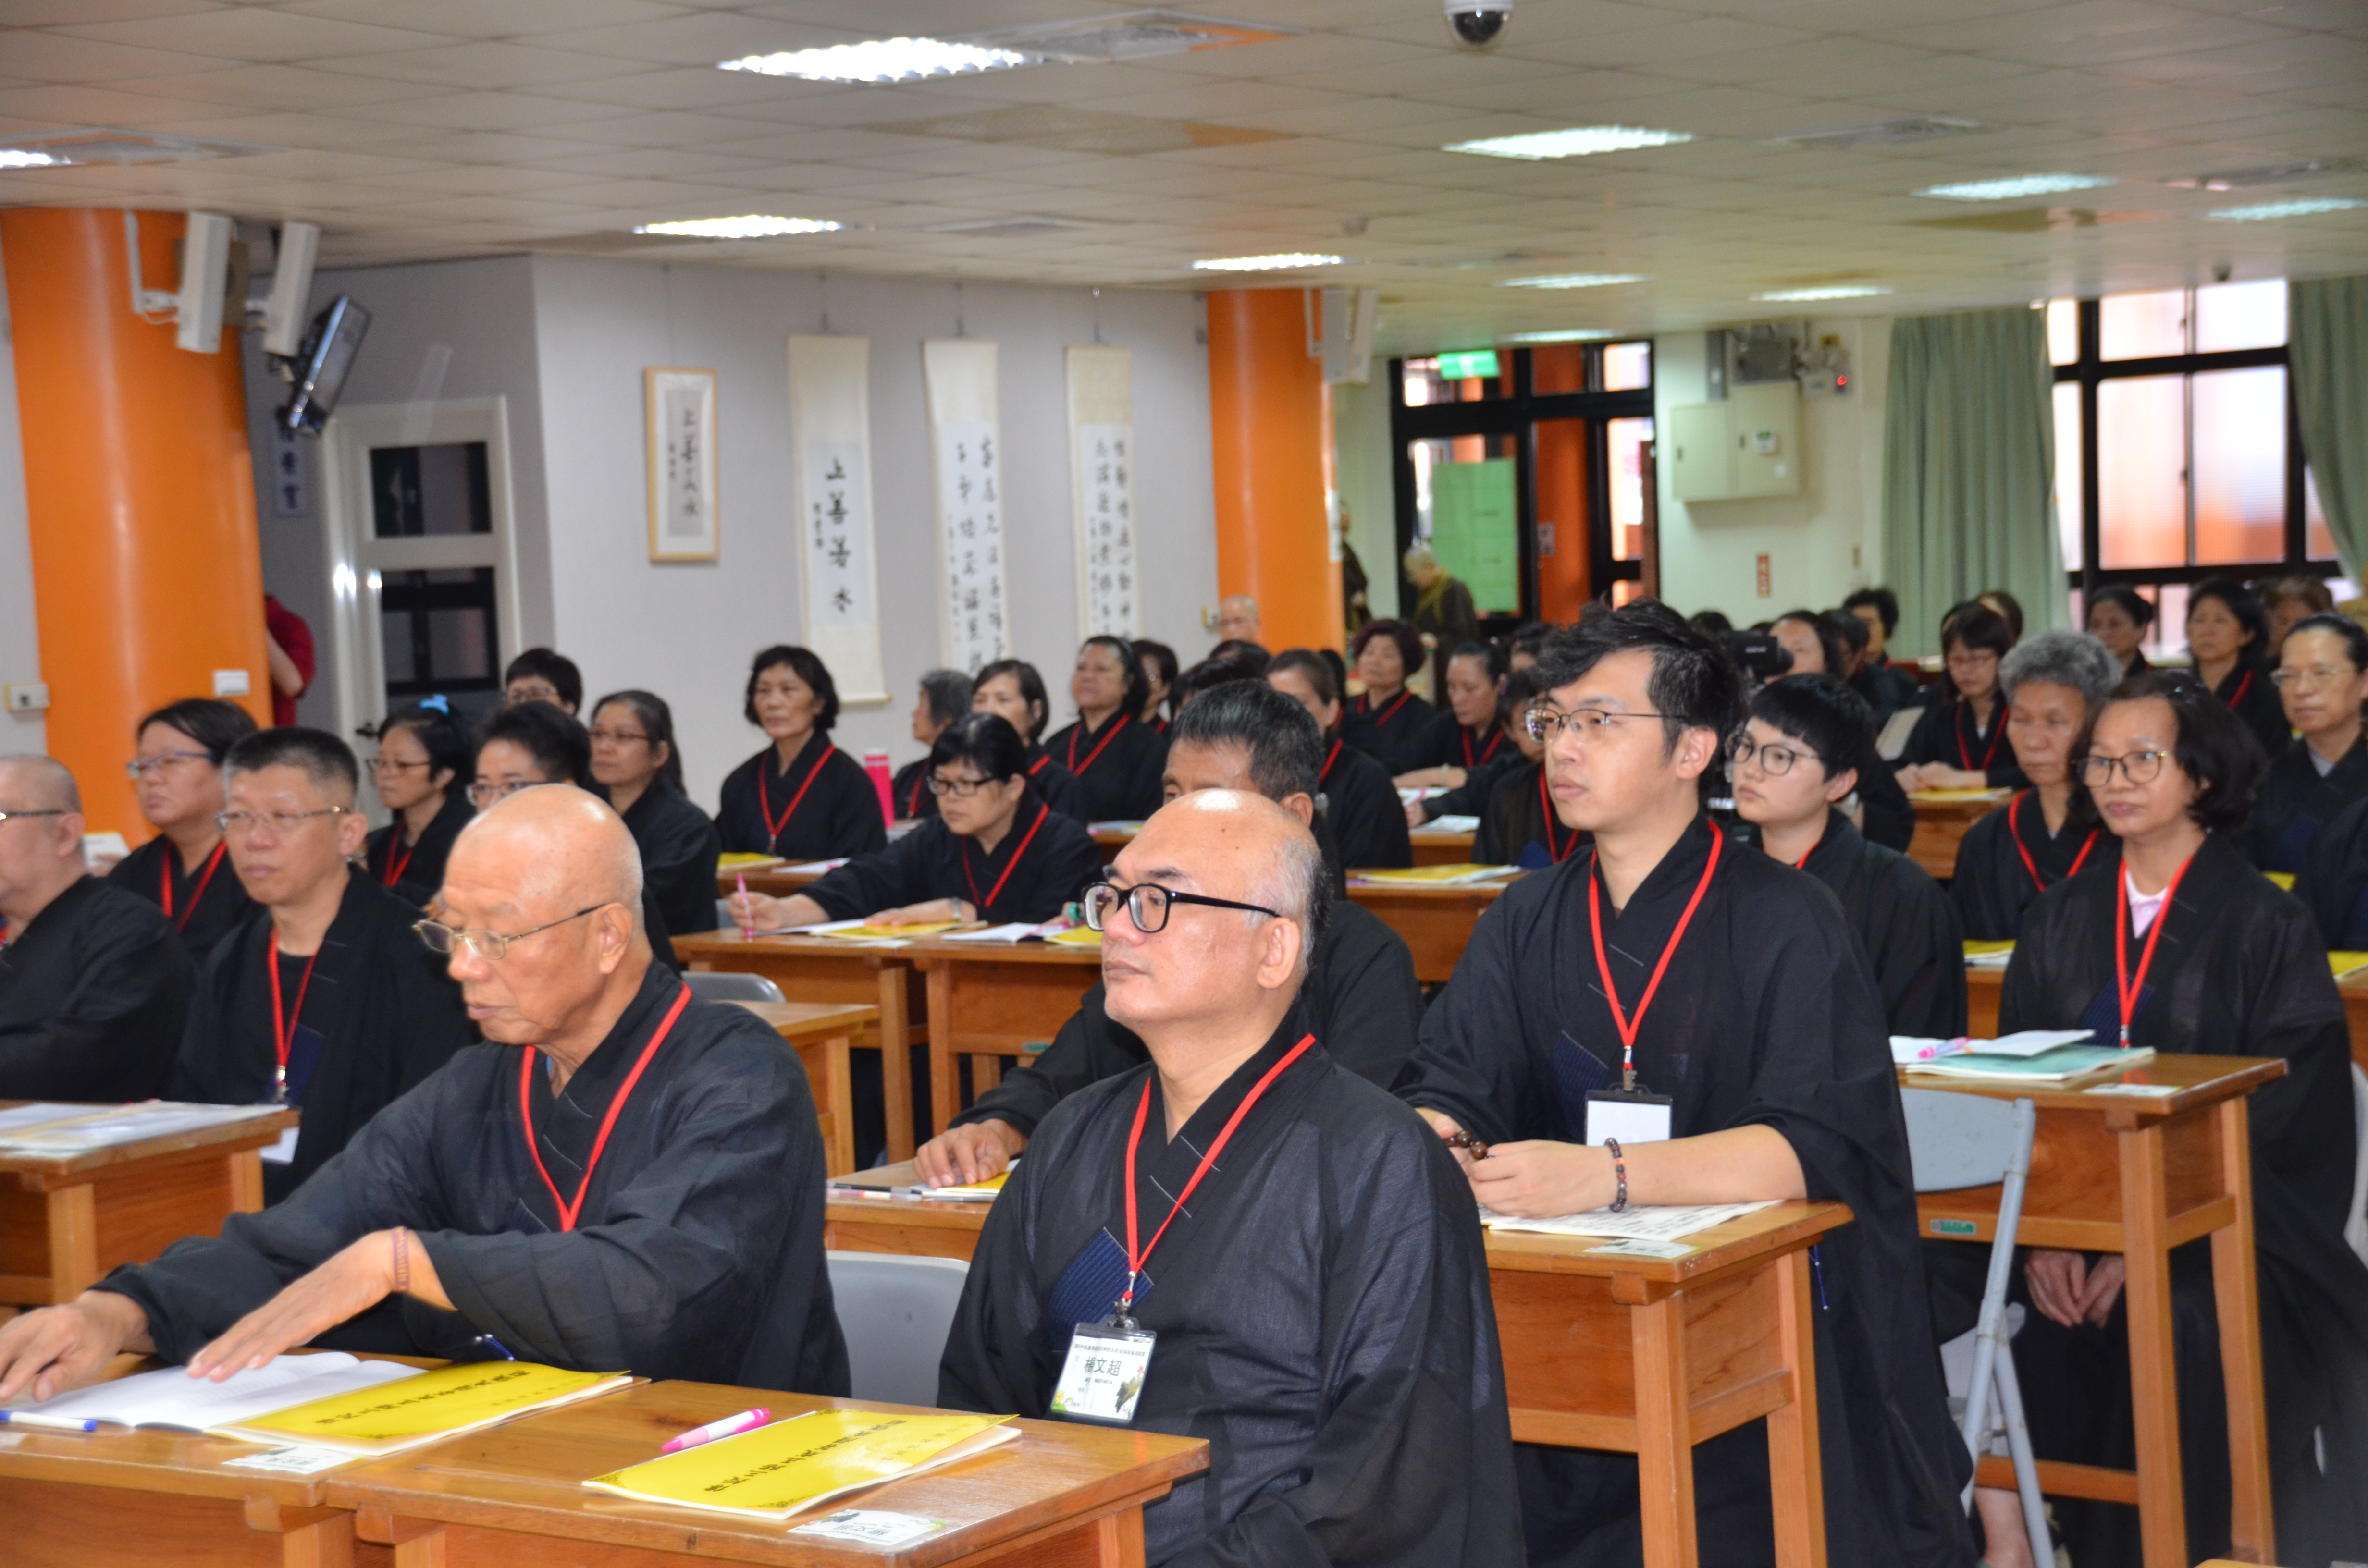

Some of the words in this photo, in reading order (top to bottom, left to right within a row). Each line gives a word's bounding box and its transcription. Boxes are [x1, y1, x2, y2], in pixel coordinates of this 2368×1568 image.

[826, 456, 853, 614] 上善若水
[1084, 1356, 1122, 1376] 楊文超
